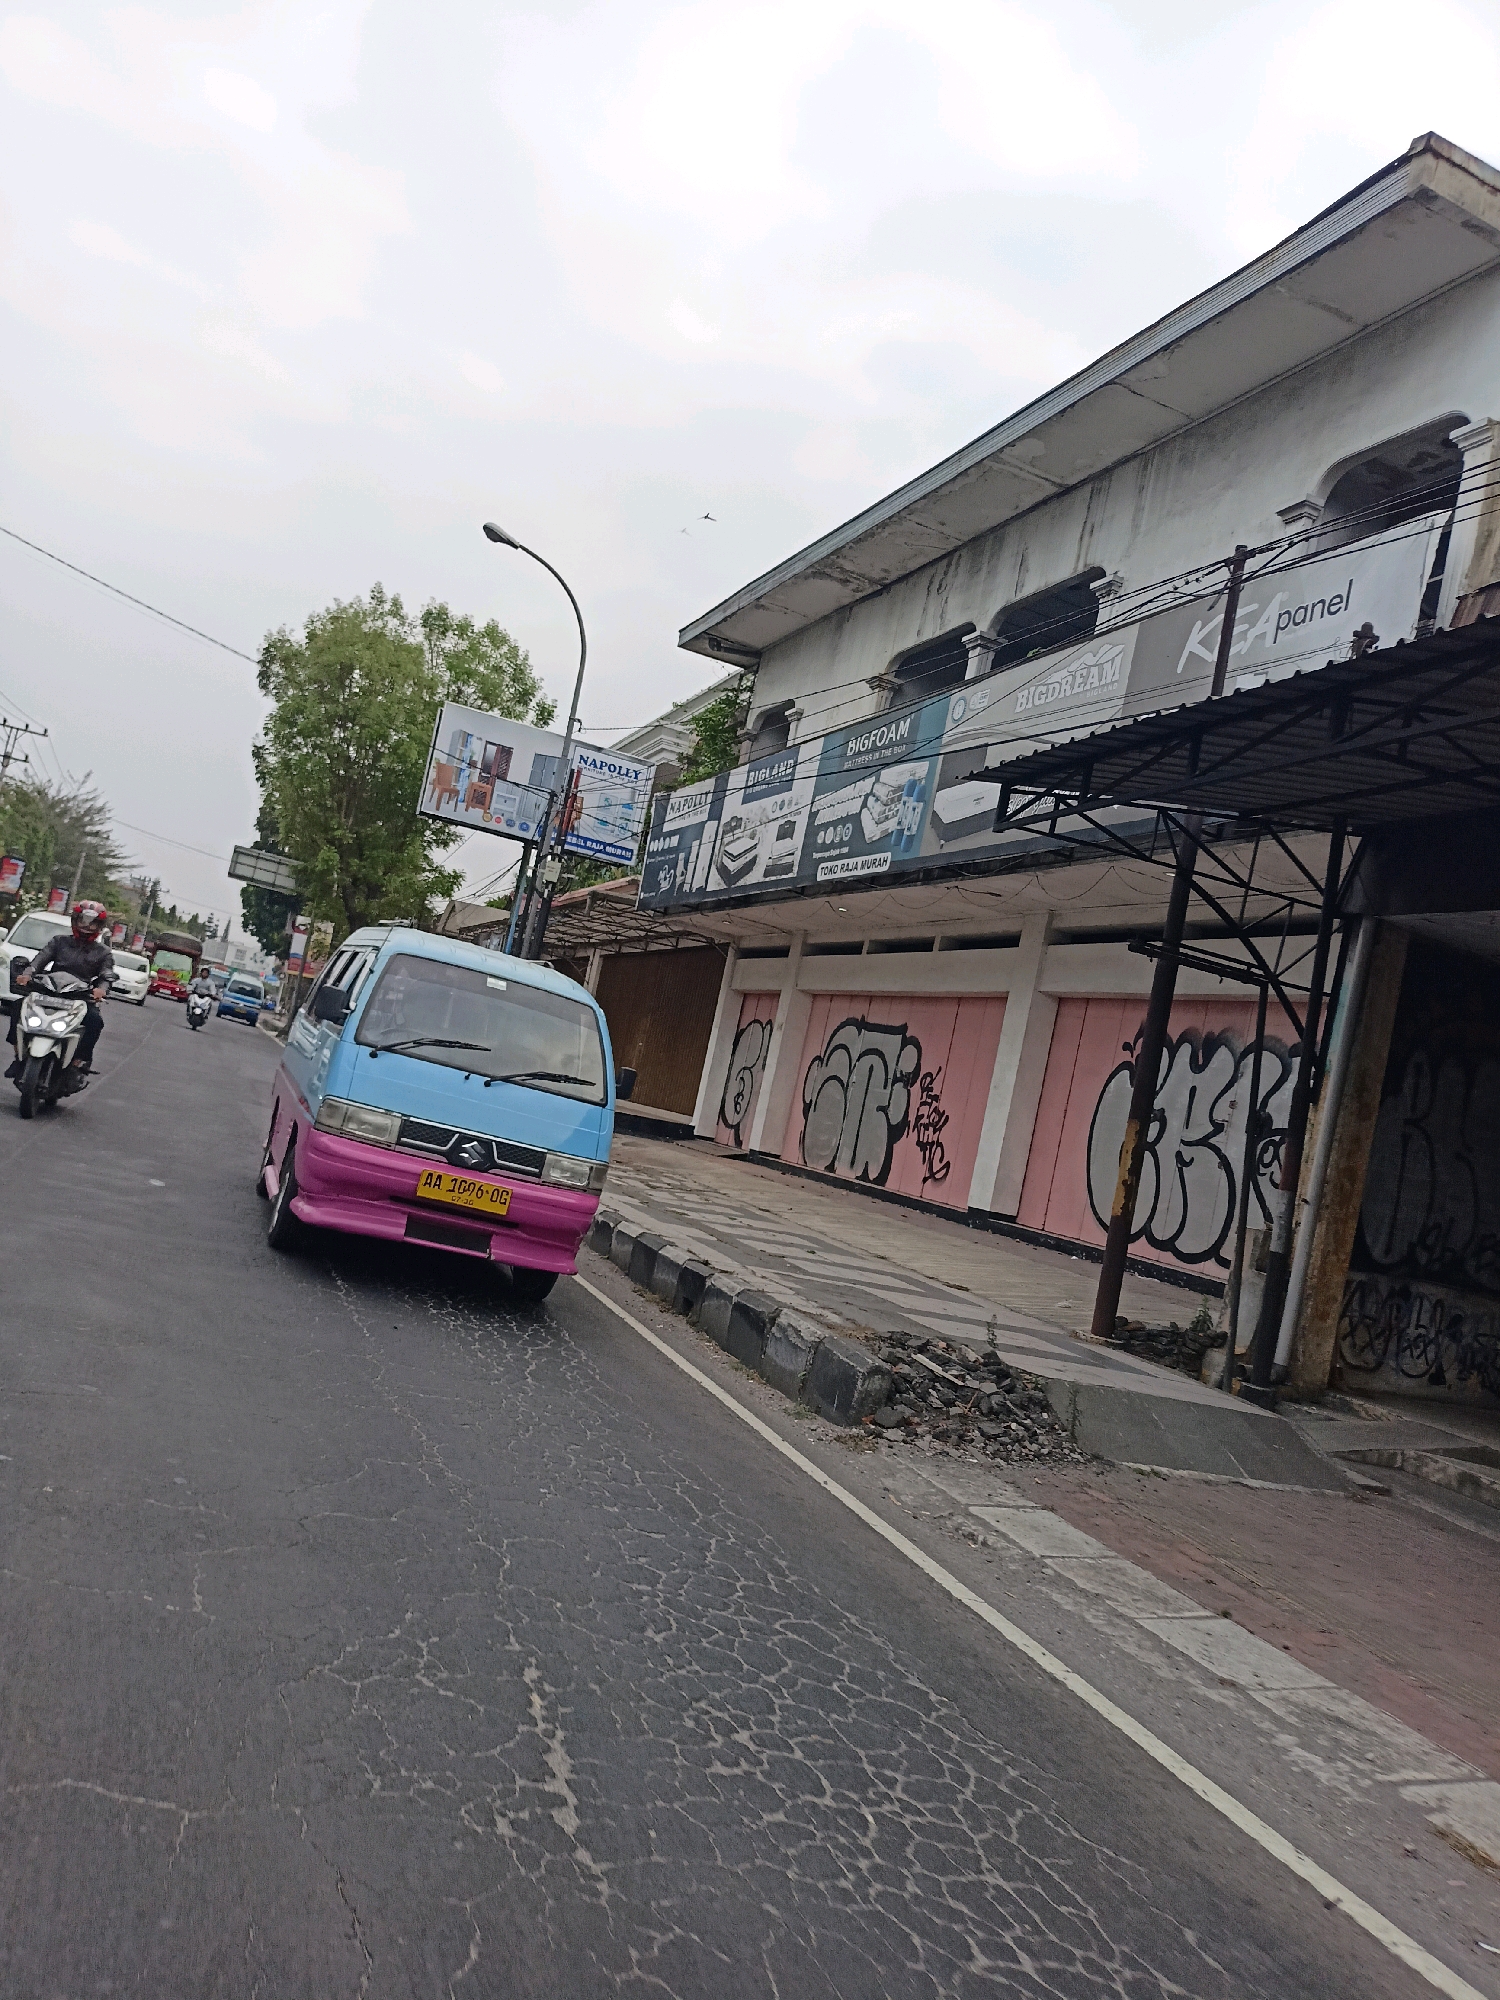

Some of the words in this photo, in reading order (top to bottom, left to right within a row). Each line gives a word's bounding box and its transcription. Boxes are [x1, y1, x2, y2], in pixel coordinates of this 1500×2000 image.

[1273, 578, 1354, 645] panel
[1015, 651, 1124, 714] BIGDREAM
[847, 717, 911, 757] BIGFOAM
[579, 755, 642, 780] NAPOLLY
[749, 759, 794, 785] BIGLAND
[668, 789, 712, 816] NAPOLLY
[820, 864, 839, 876] TOKO
[840, 861, 858, 873] RAJA
[860, 856, 889, 870] MURAH
[423, 1172, 442, 1190] AA
